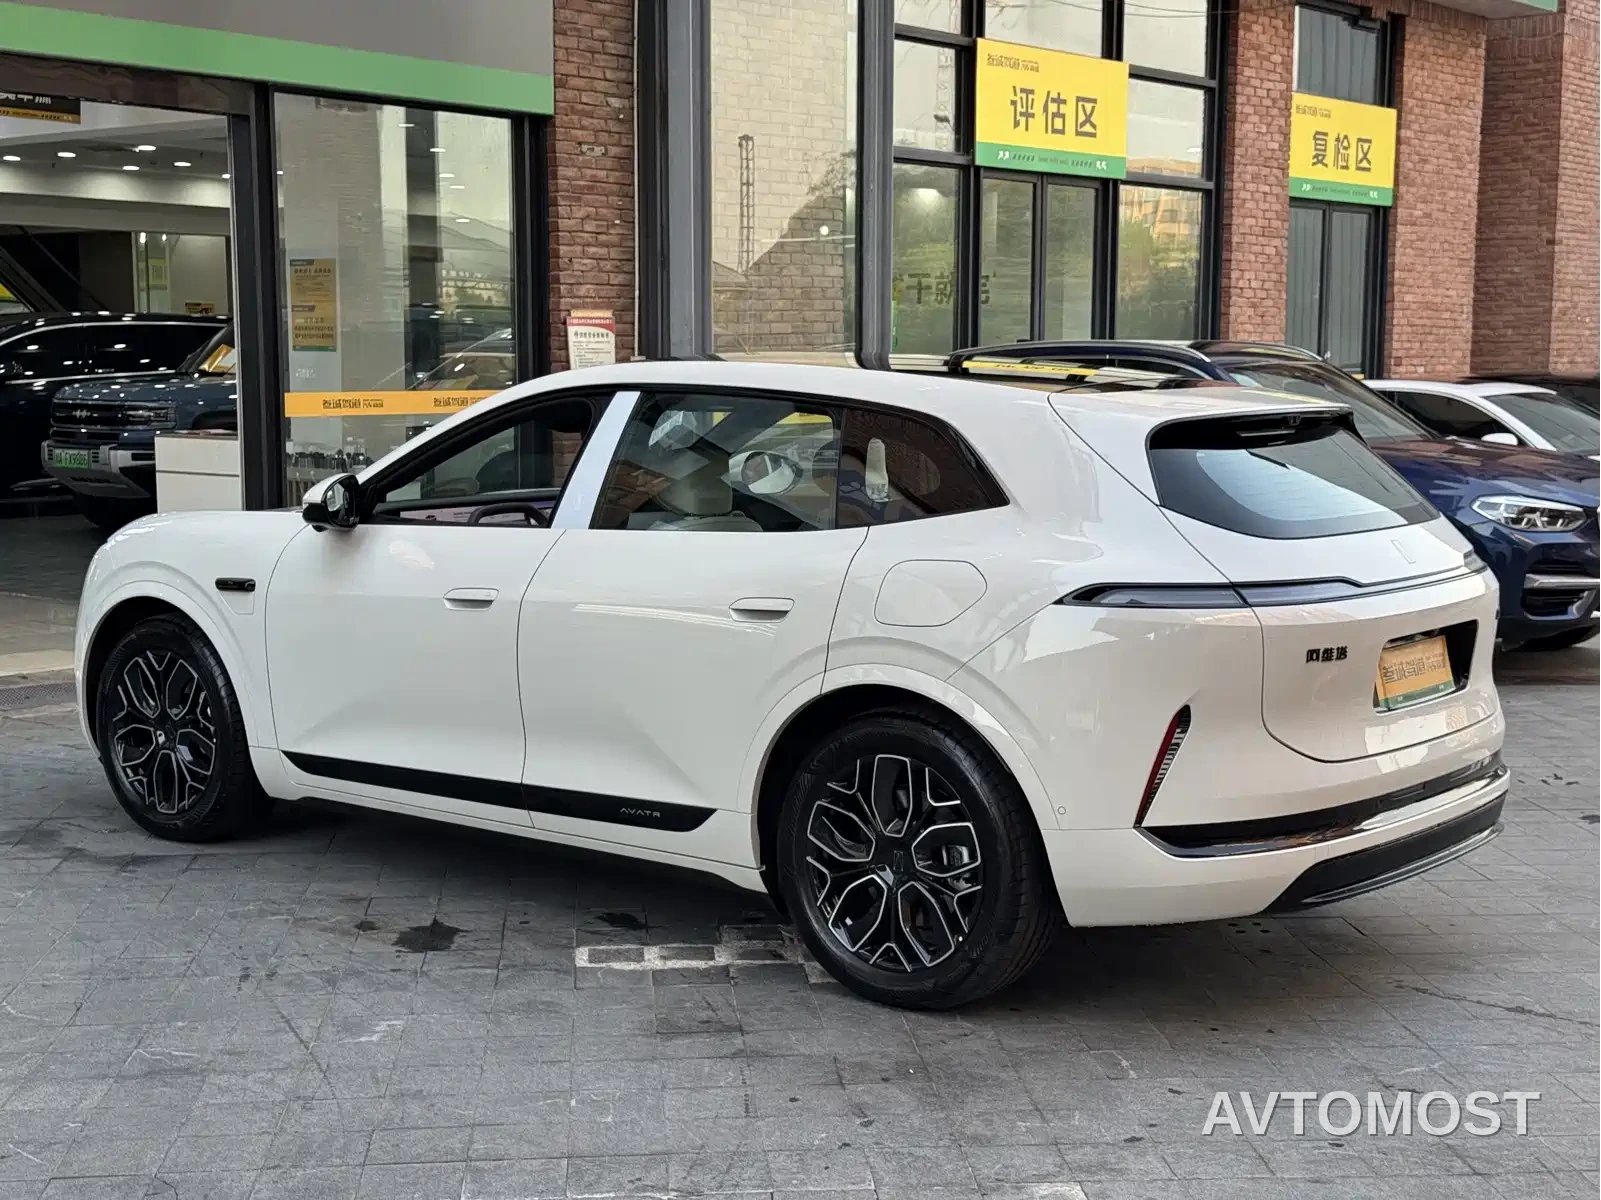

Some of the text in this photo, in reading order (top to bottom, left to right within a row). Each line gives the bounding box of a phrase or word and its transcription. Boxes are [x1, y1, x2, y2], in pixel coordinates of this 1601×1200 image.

[1010, 85, 1098, 138] 评估区
[1311, 130, 1372, 172] 复检区
[1306, 645, 1348, 664] 阿维塔
[620, 807, 660, 817] AVATR
